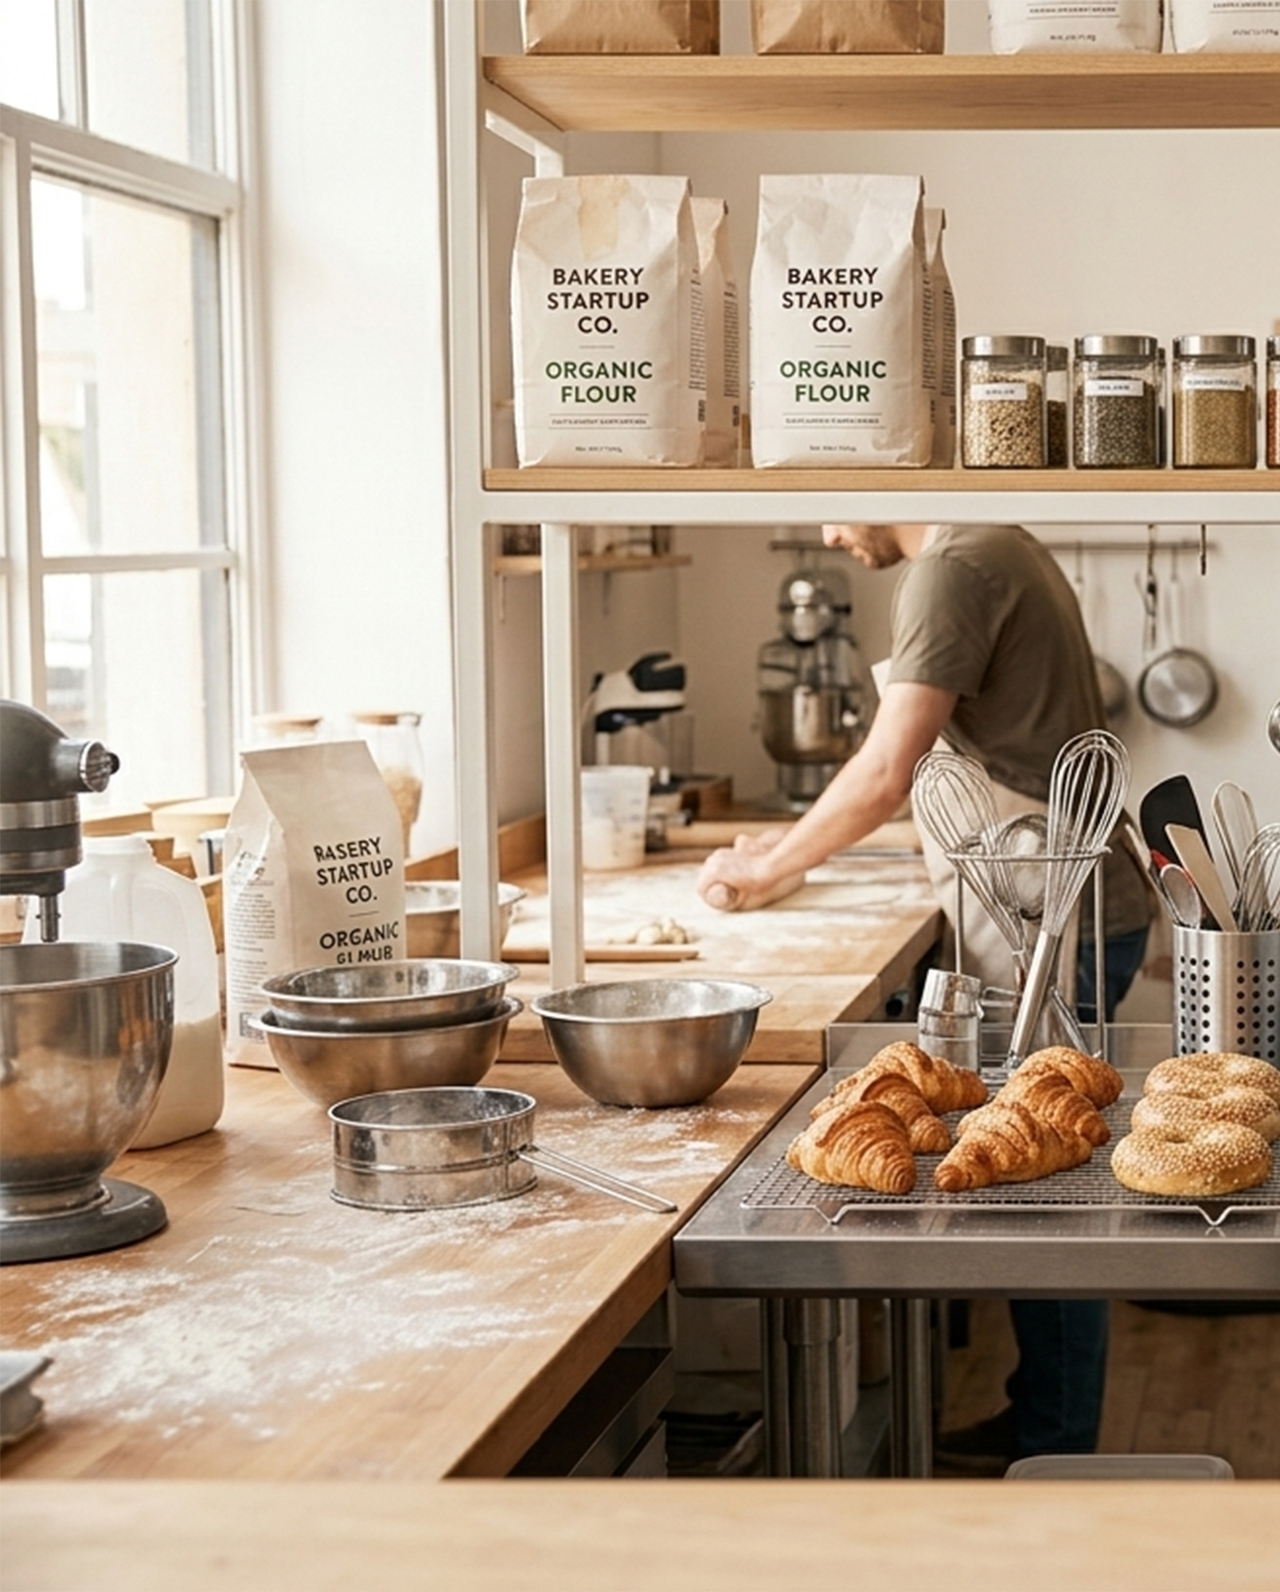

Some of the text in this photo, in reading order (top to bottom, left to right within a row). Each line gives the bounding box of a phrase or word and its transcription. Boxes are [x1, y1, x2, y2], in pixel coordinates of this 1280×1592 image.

[553, 268, 644, 286] BAKERY
[787, 267, 878, 285] BAKERY
[547, 291, 650, 310] STARTUP
[782, 291, 884, 309] STARTUP
[577, 315, 618, 334] CO.
[812, 315, 853, 333] CO.
[545, 361, 653, 380] ORGANIC
[780, 360, 887, 379] ORGANIC
[561, 385, 637, 403] FLOUR
[795, 384, 870, 403] FLOUR
[316, 858, 394, 886] STARTUP
[345, 884, 378, 904] CO.
[319, 921, 399, 950] ORGANIC
